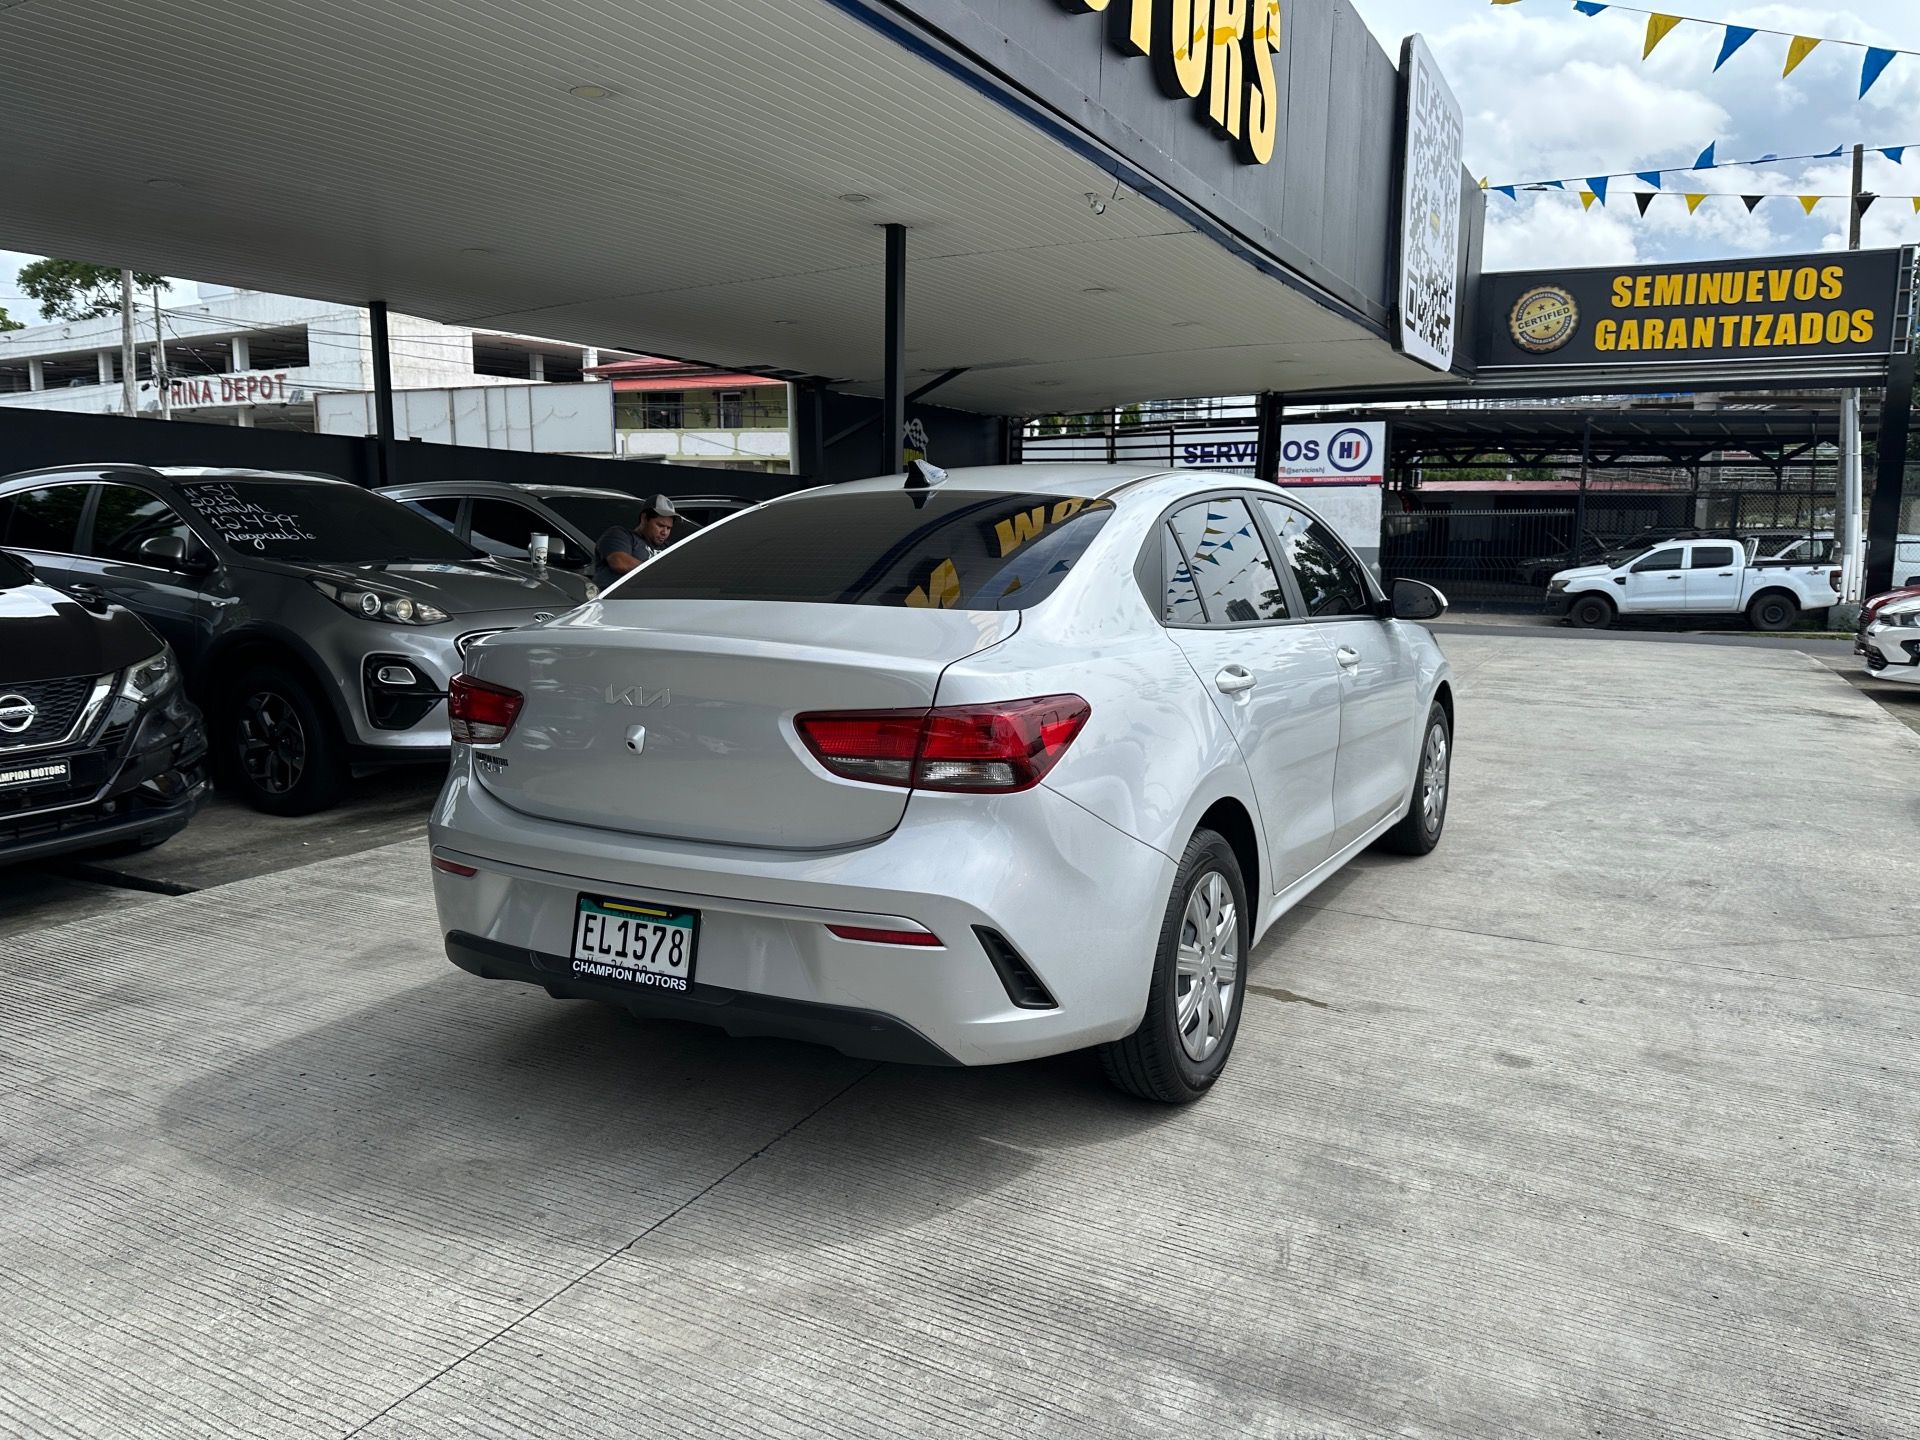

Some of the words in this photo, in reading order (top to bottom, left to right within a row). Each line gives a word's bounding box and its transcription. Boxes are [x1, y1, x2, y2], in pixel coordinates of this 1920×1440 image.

[1611, 265, 1844, 308] SEMINUEVOS
[1517, 306, 1570, 330] CERTIFIED
[1594, 308, 1875, 351] GARANTIZADOS
[220, 373, 287, 402] DEPOT
[1338, 440, 1361, 460] HJ
[190, 494, 243, 507] 2019
[198, 503, 272, 516] MANUAL
[31, 764, 67, 778] MOTORS
[582, 913, 685, 968] EL1578
[572, 960, 633, 981] CHAMPION
[635, 969, 687, 991] MOTORS
